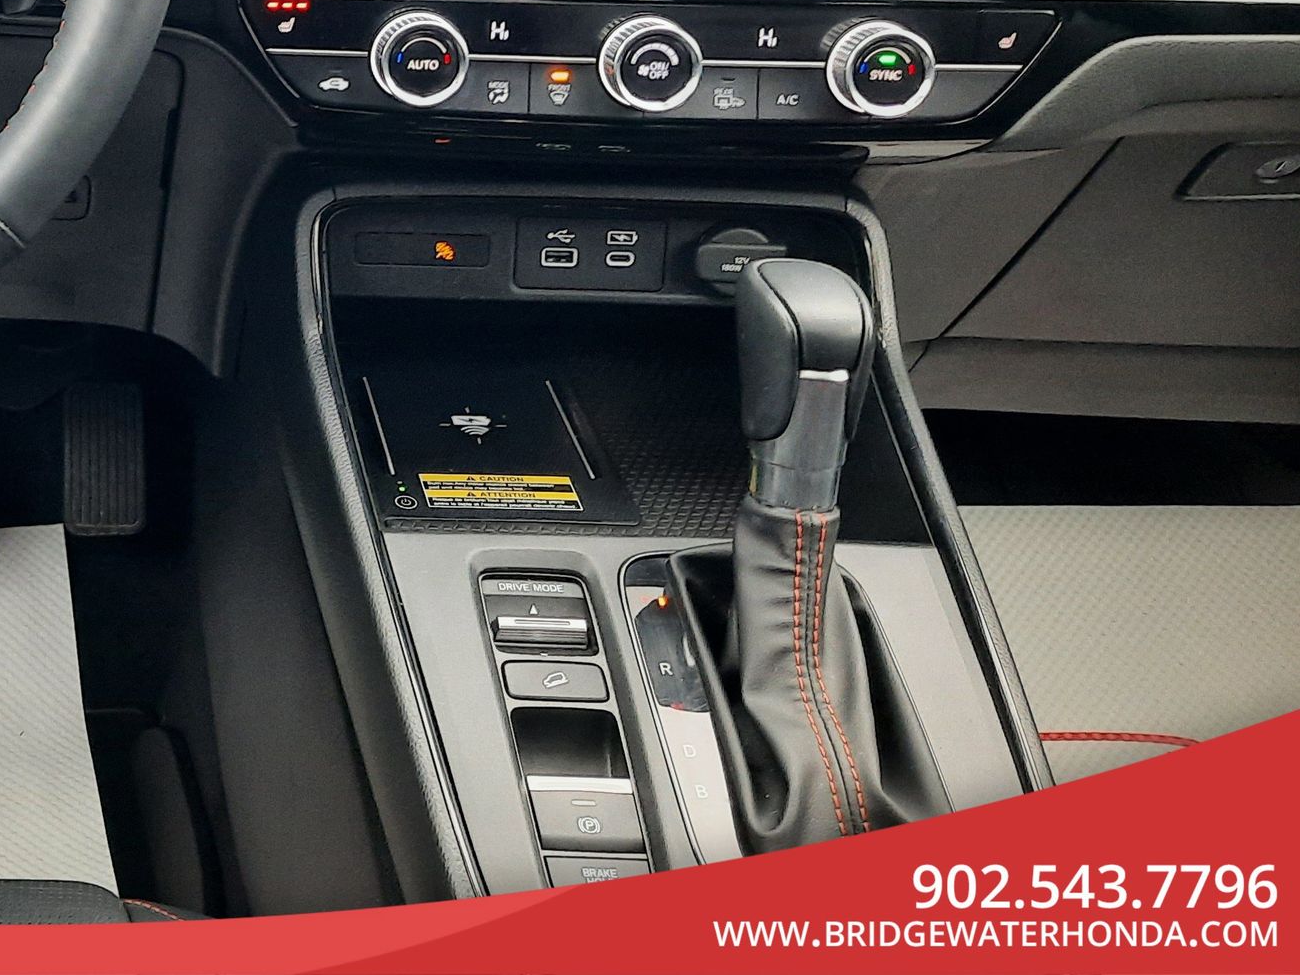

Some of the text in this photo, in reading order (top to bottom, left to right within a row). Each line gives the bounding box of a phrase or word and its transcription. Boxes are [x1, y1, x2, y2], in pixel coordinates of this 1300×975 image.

[407, 58, 440, 71] AUTO
[649, 70, 669, 80] OFF
[869, 69, 903, 81] SYNC
[776, 94, 799, 106] A/C
[498, 582, 564, 593] DRIVE MODE
[659, 662, 673, 676] R
[684, 745, 697, 758] D
[695, 785, 709, 799] B
[582, 867, 618, 878] BRAKE
